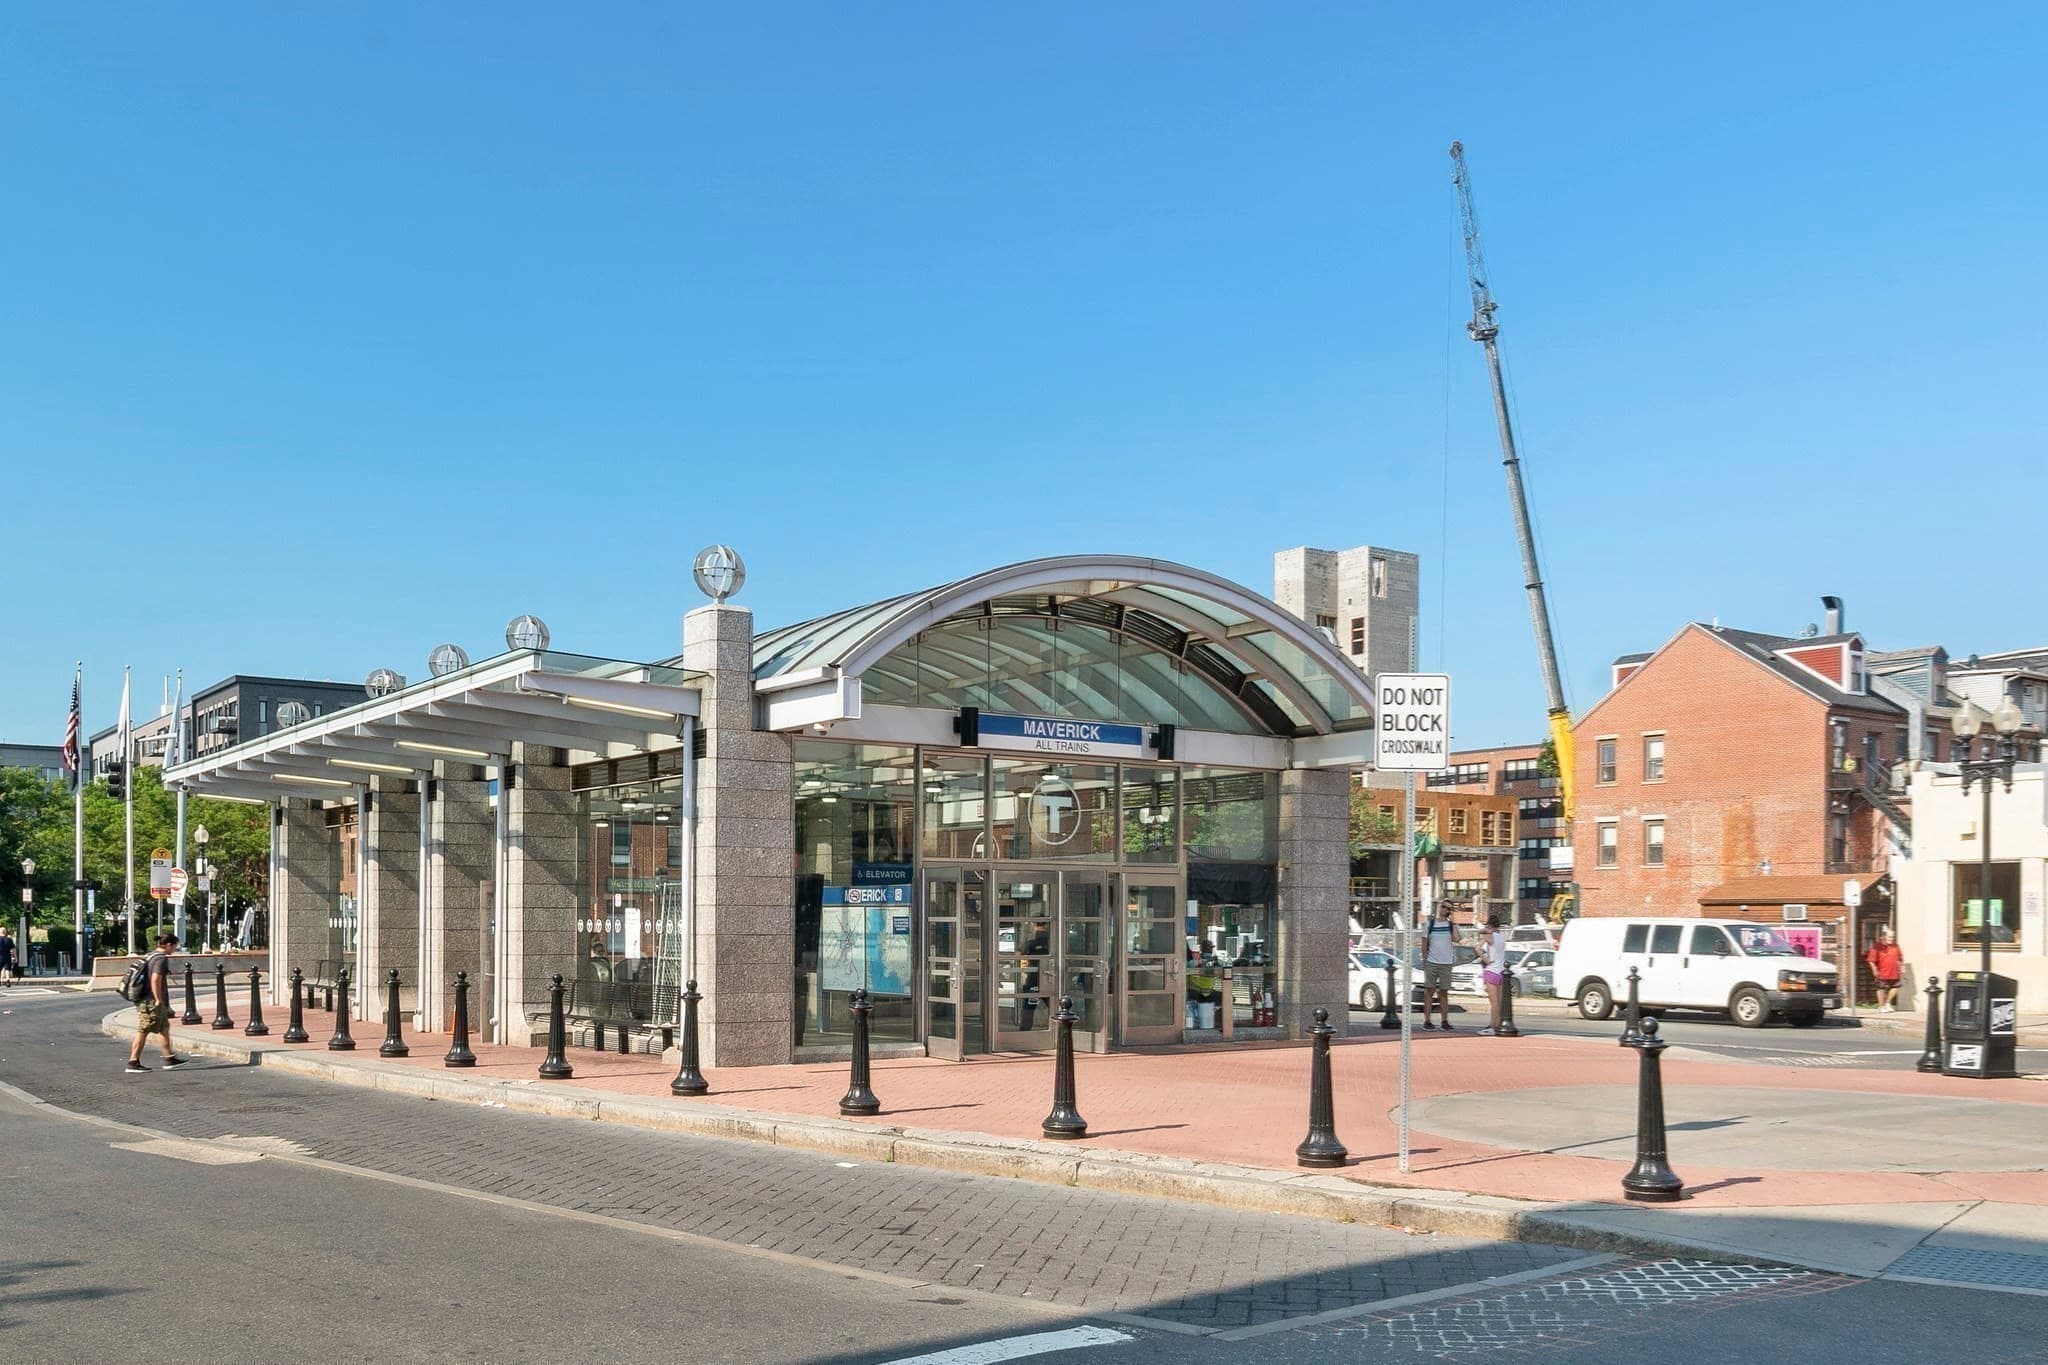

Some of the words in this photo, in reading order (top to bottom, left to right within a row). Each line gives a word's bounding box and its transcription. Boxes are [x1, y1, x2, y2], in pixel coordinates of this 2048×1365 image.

[1383, 688, 1405, 705] DO
[1411, 688, 1443, 705] NOT
[1023, 720, 1100, 740] MAVERICK
[1383, 714, 1442, 731] BLOCK
[1035, 739, 1052, 750] ALL
[1056, 741, 1089, 752] TRAINS
[1382, 740, 1442, 753] CROSSWALK
[1038, 795, 1072, 833] T
[866, 870, 906, 878] ELEVATOR
[844, 888, 887, 902] MERICK
